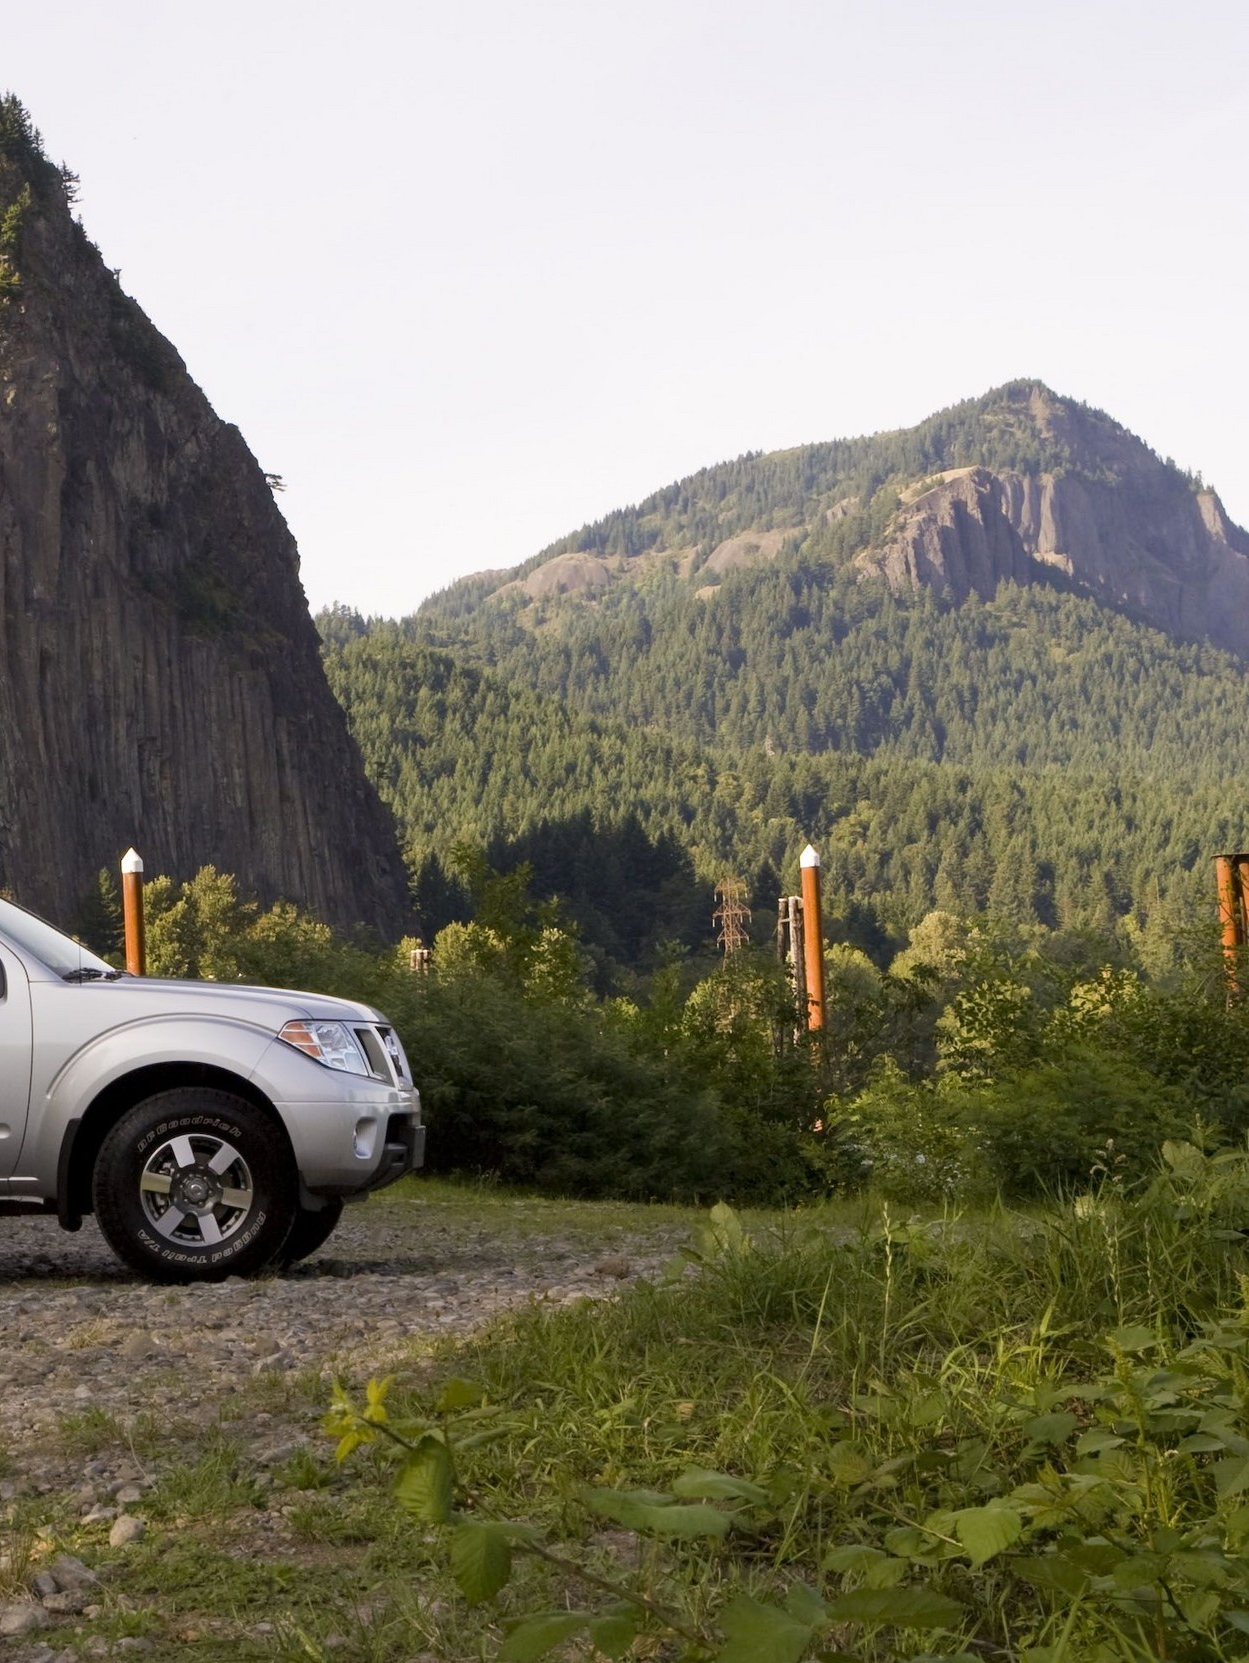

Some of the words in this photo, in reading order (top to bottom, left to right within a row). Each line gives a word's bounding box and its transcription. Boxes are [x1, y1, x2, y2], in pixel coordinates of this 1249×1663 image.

[137, 1228, 161, 1252] T/A
[211, 1211, 267, 1263] Rugged
[161, 1249, 207, 1264] Trail
